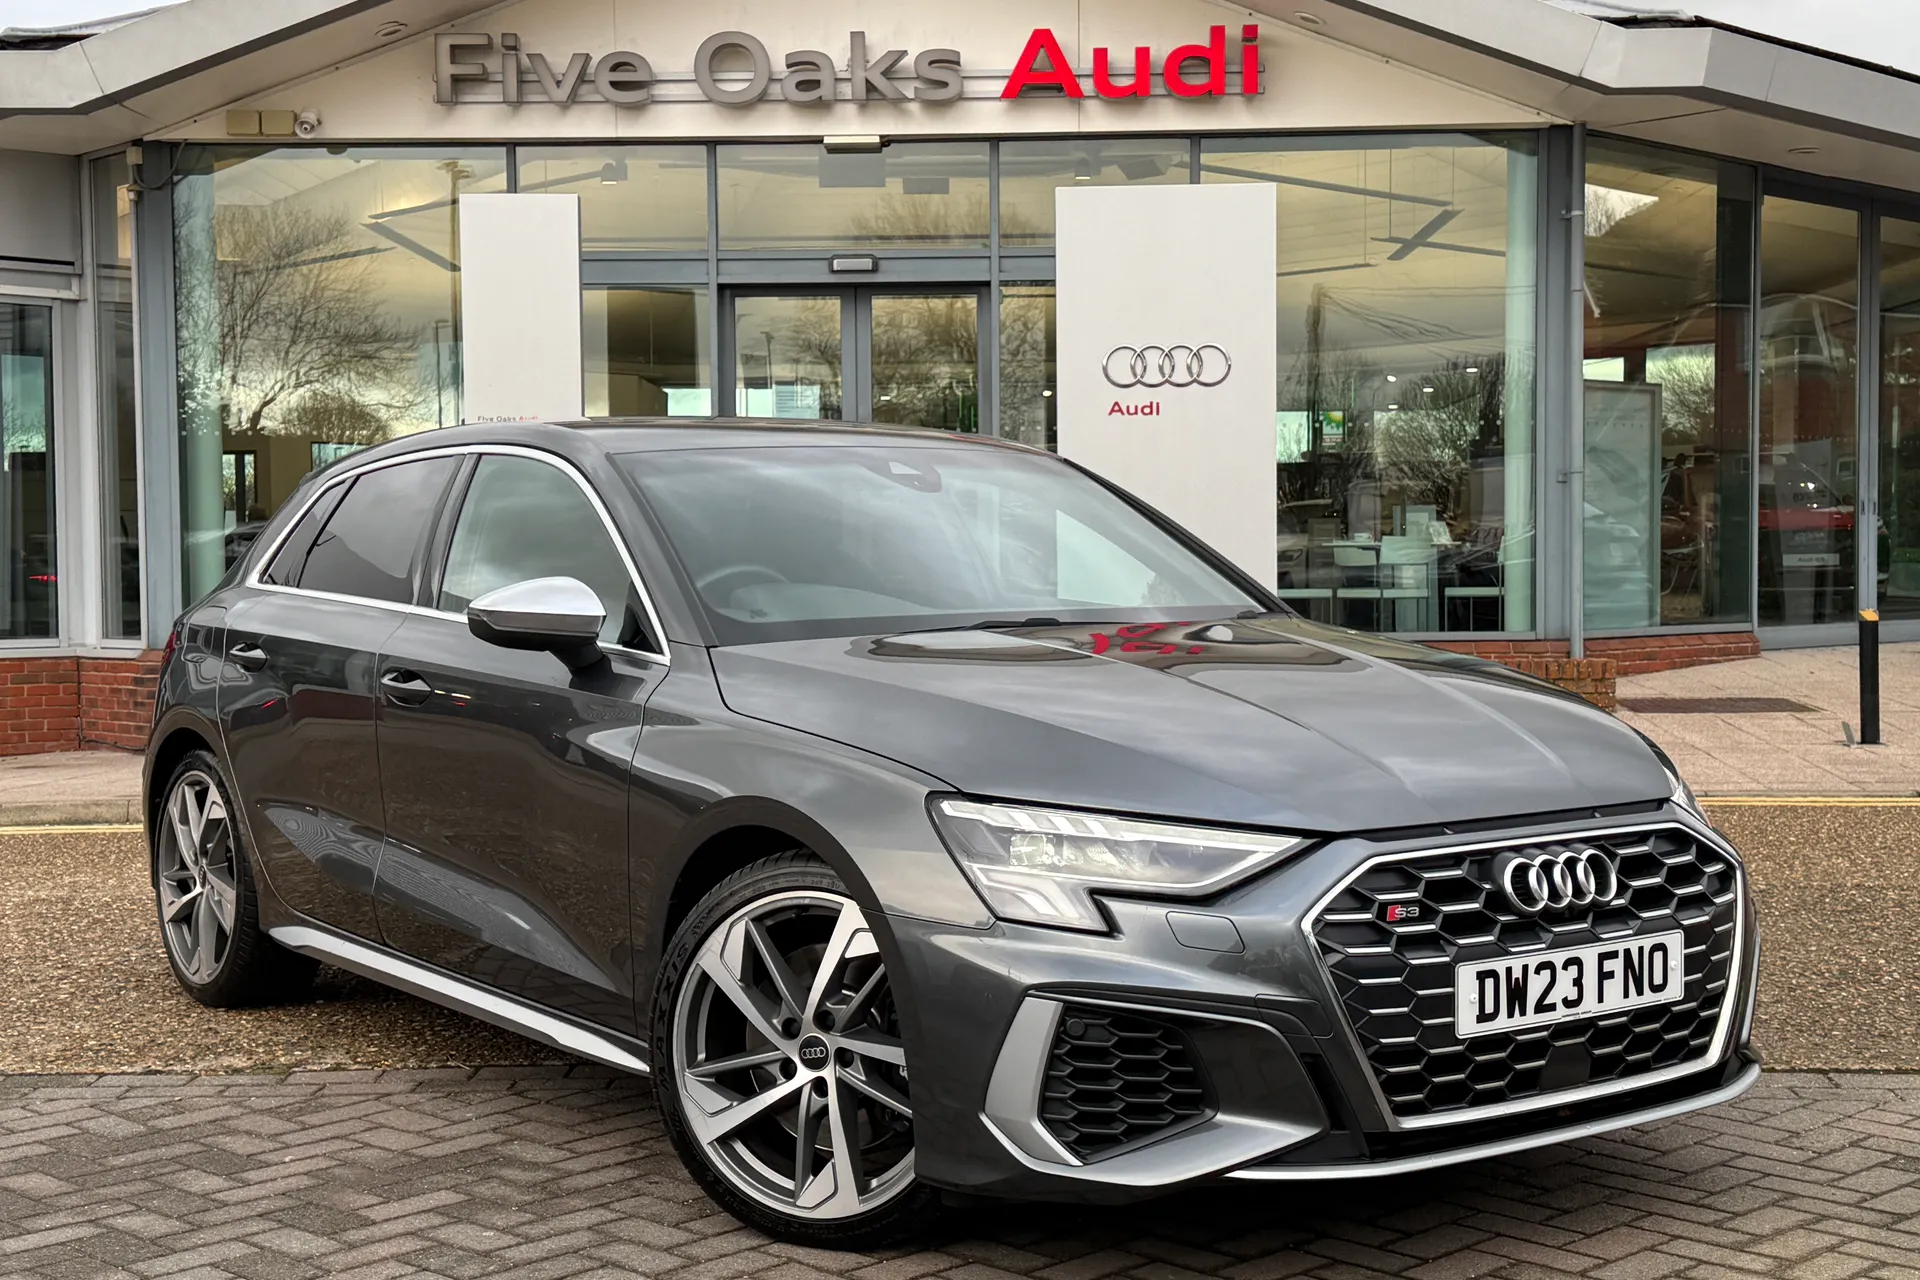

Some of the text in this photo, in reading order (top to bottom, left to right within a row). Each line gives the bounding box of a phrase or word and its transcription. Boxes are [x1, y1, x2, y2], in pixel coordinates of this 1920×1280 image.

[434, 24, 1259, 106] Five Oaks Audi
[1108, 401, 1160, 416] Audi
[1394, 906, 1420, 919] S3
[655, 943, 689, 1092] MAXXIS
[1475, 941, 1669, 1024] DW23 FNO
